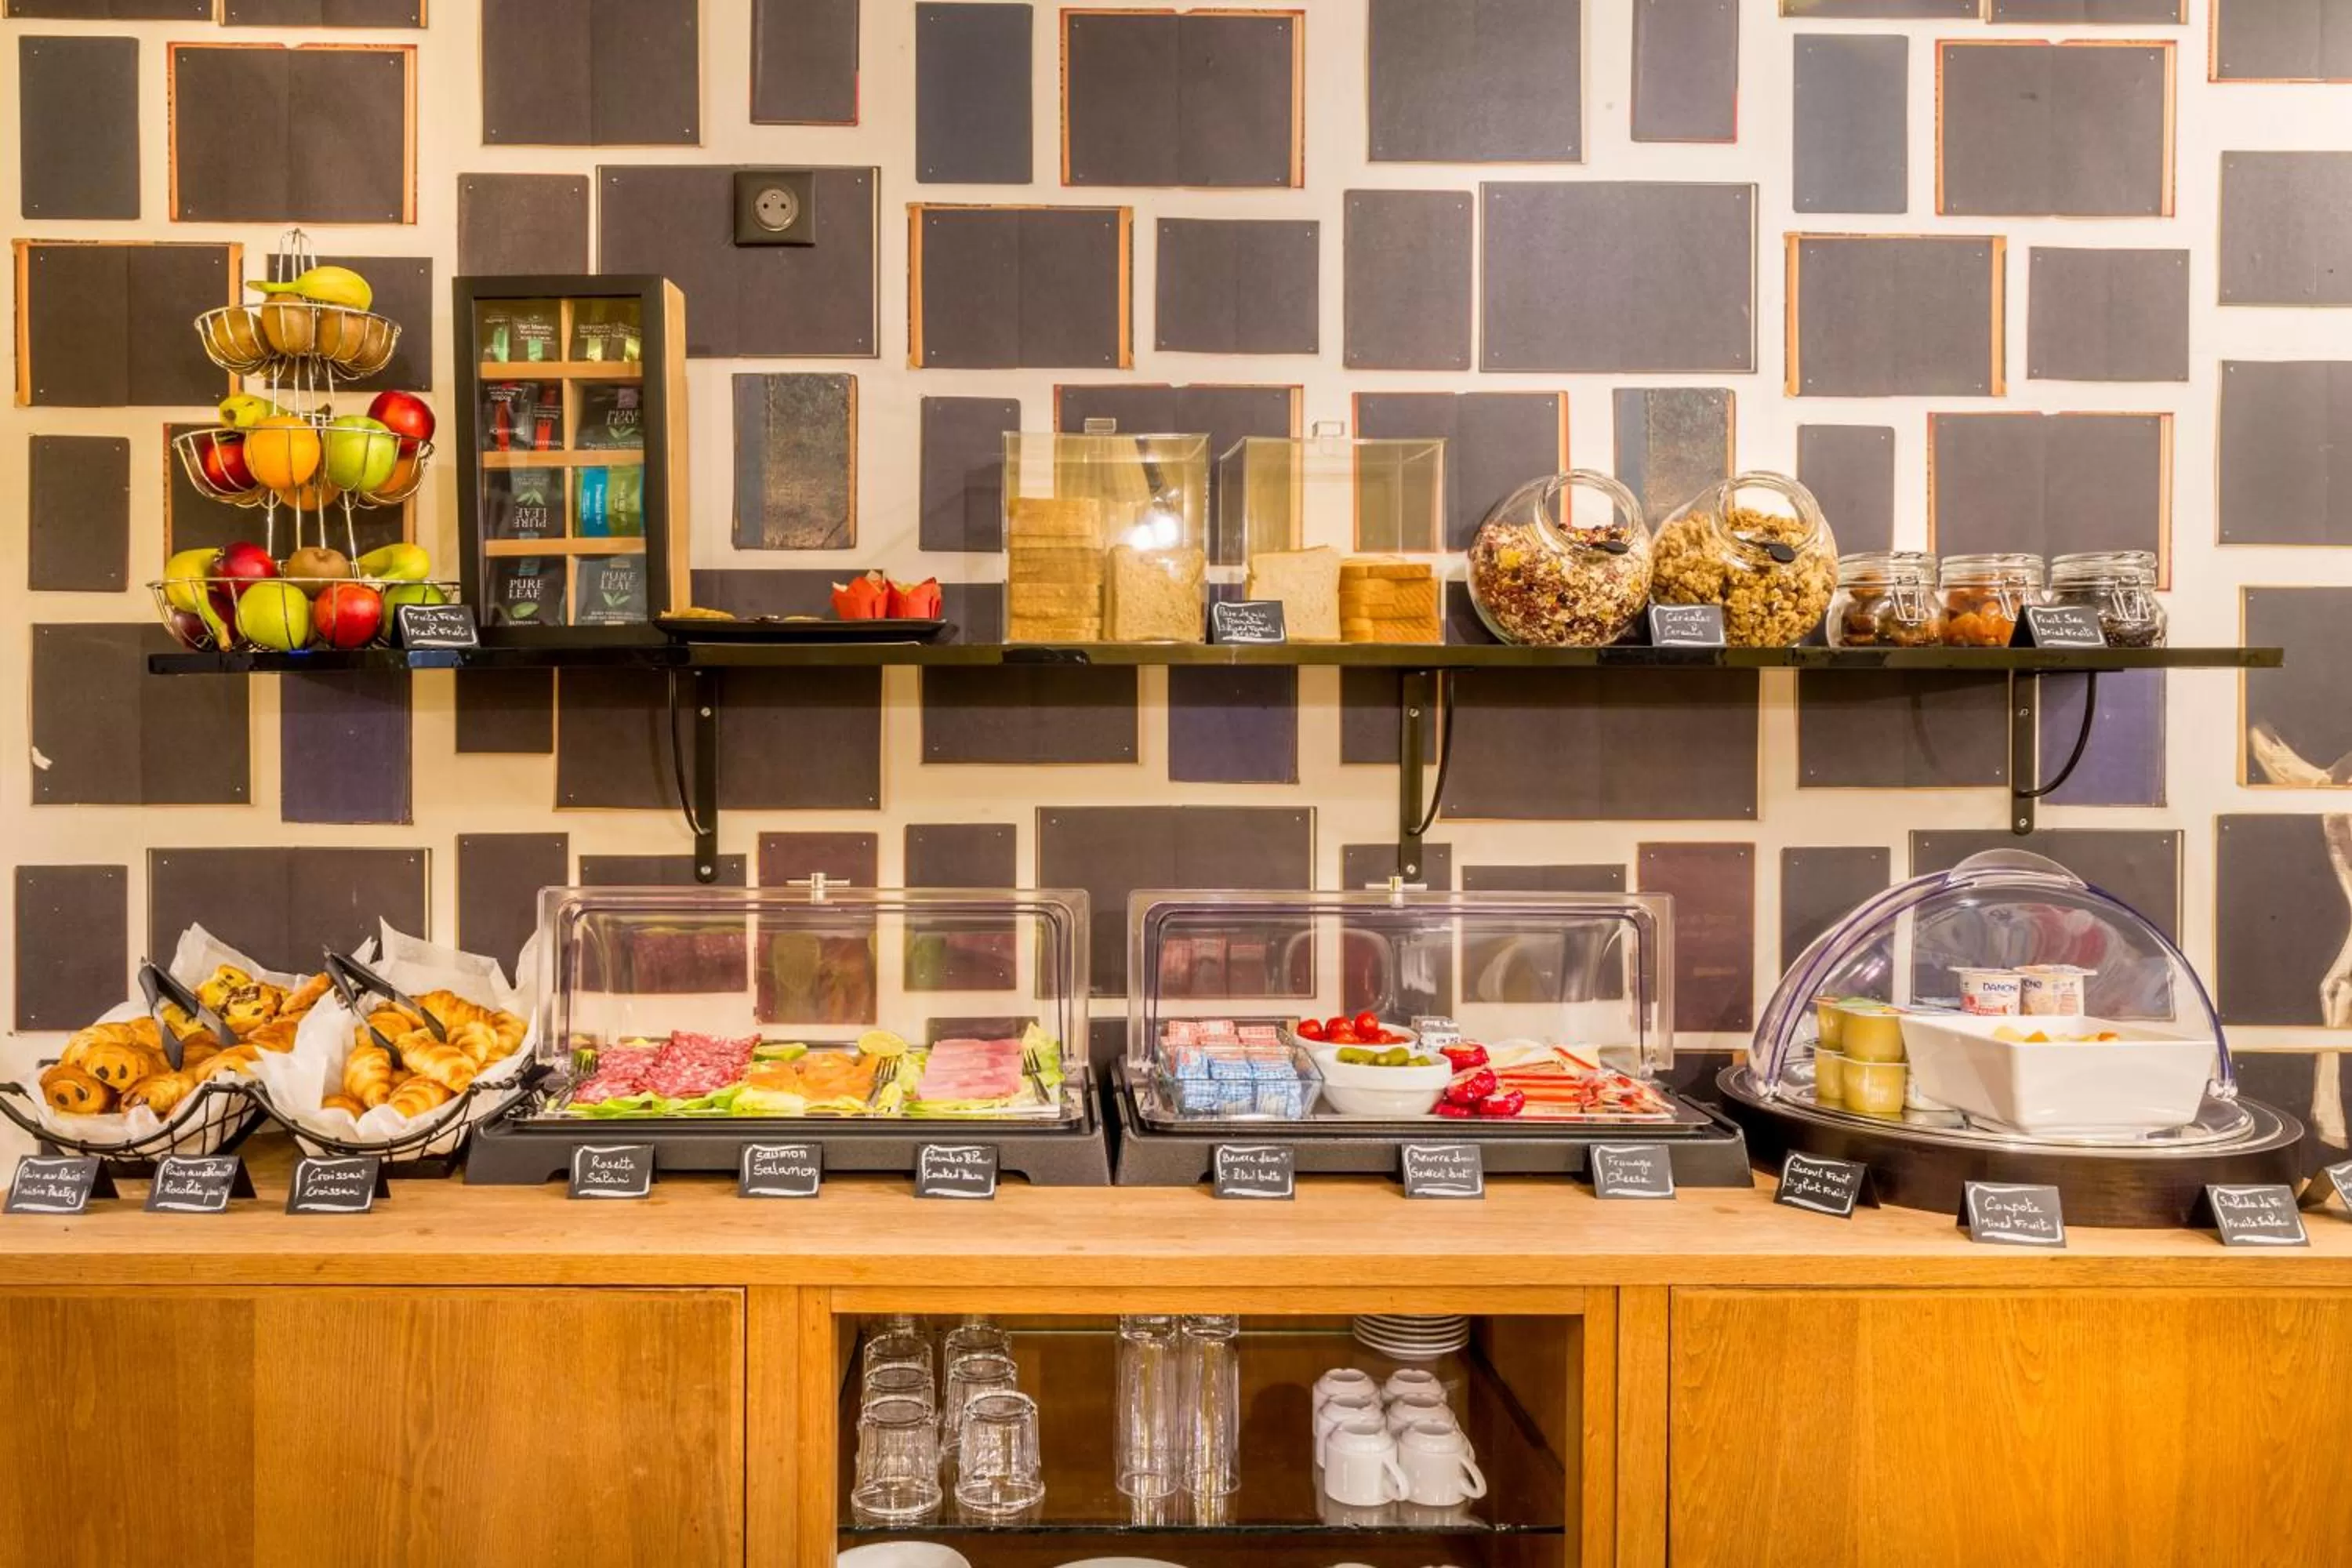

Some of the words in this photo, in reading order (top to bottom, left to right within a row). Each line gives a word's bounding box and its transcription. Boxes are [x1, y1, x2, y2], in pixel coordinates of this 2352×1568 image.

[601, 571, 637, 580] PURE
[509, 579, 544, 589] PURE
[509, 589, 541, 600] LEAF
